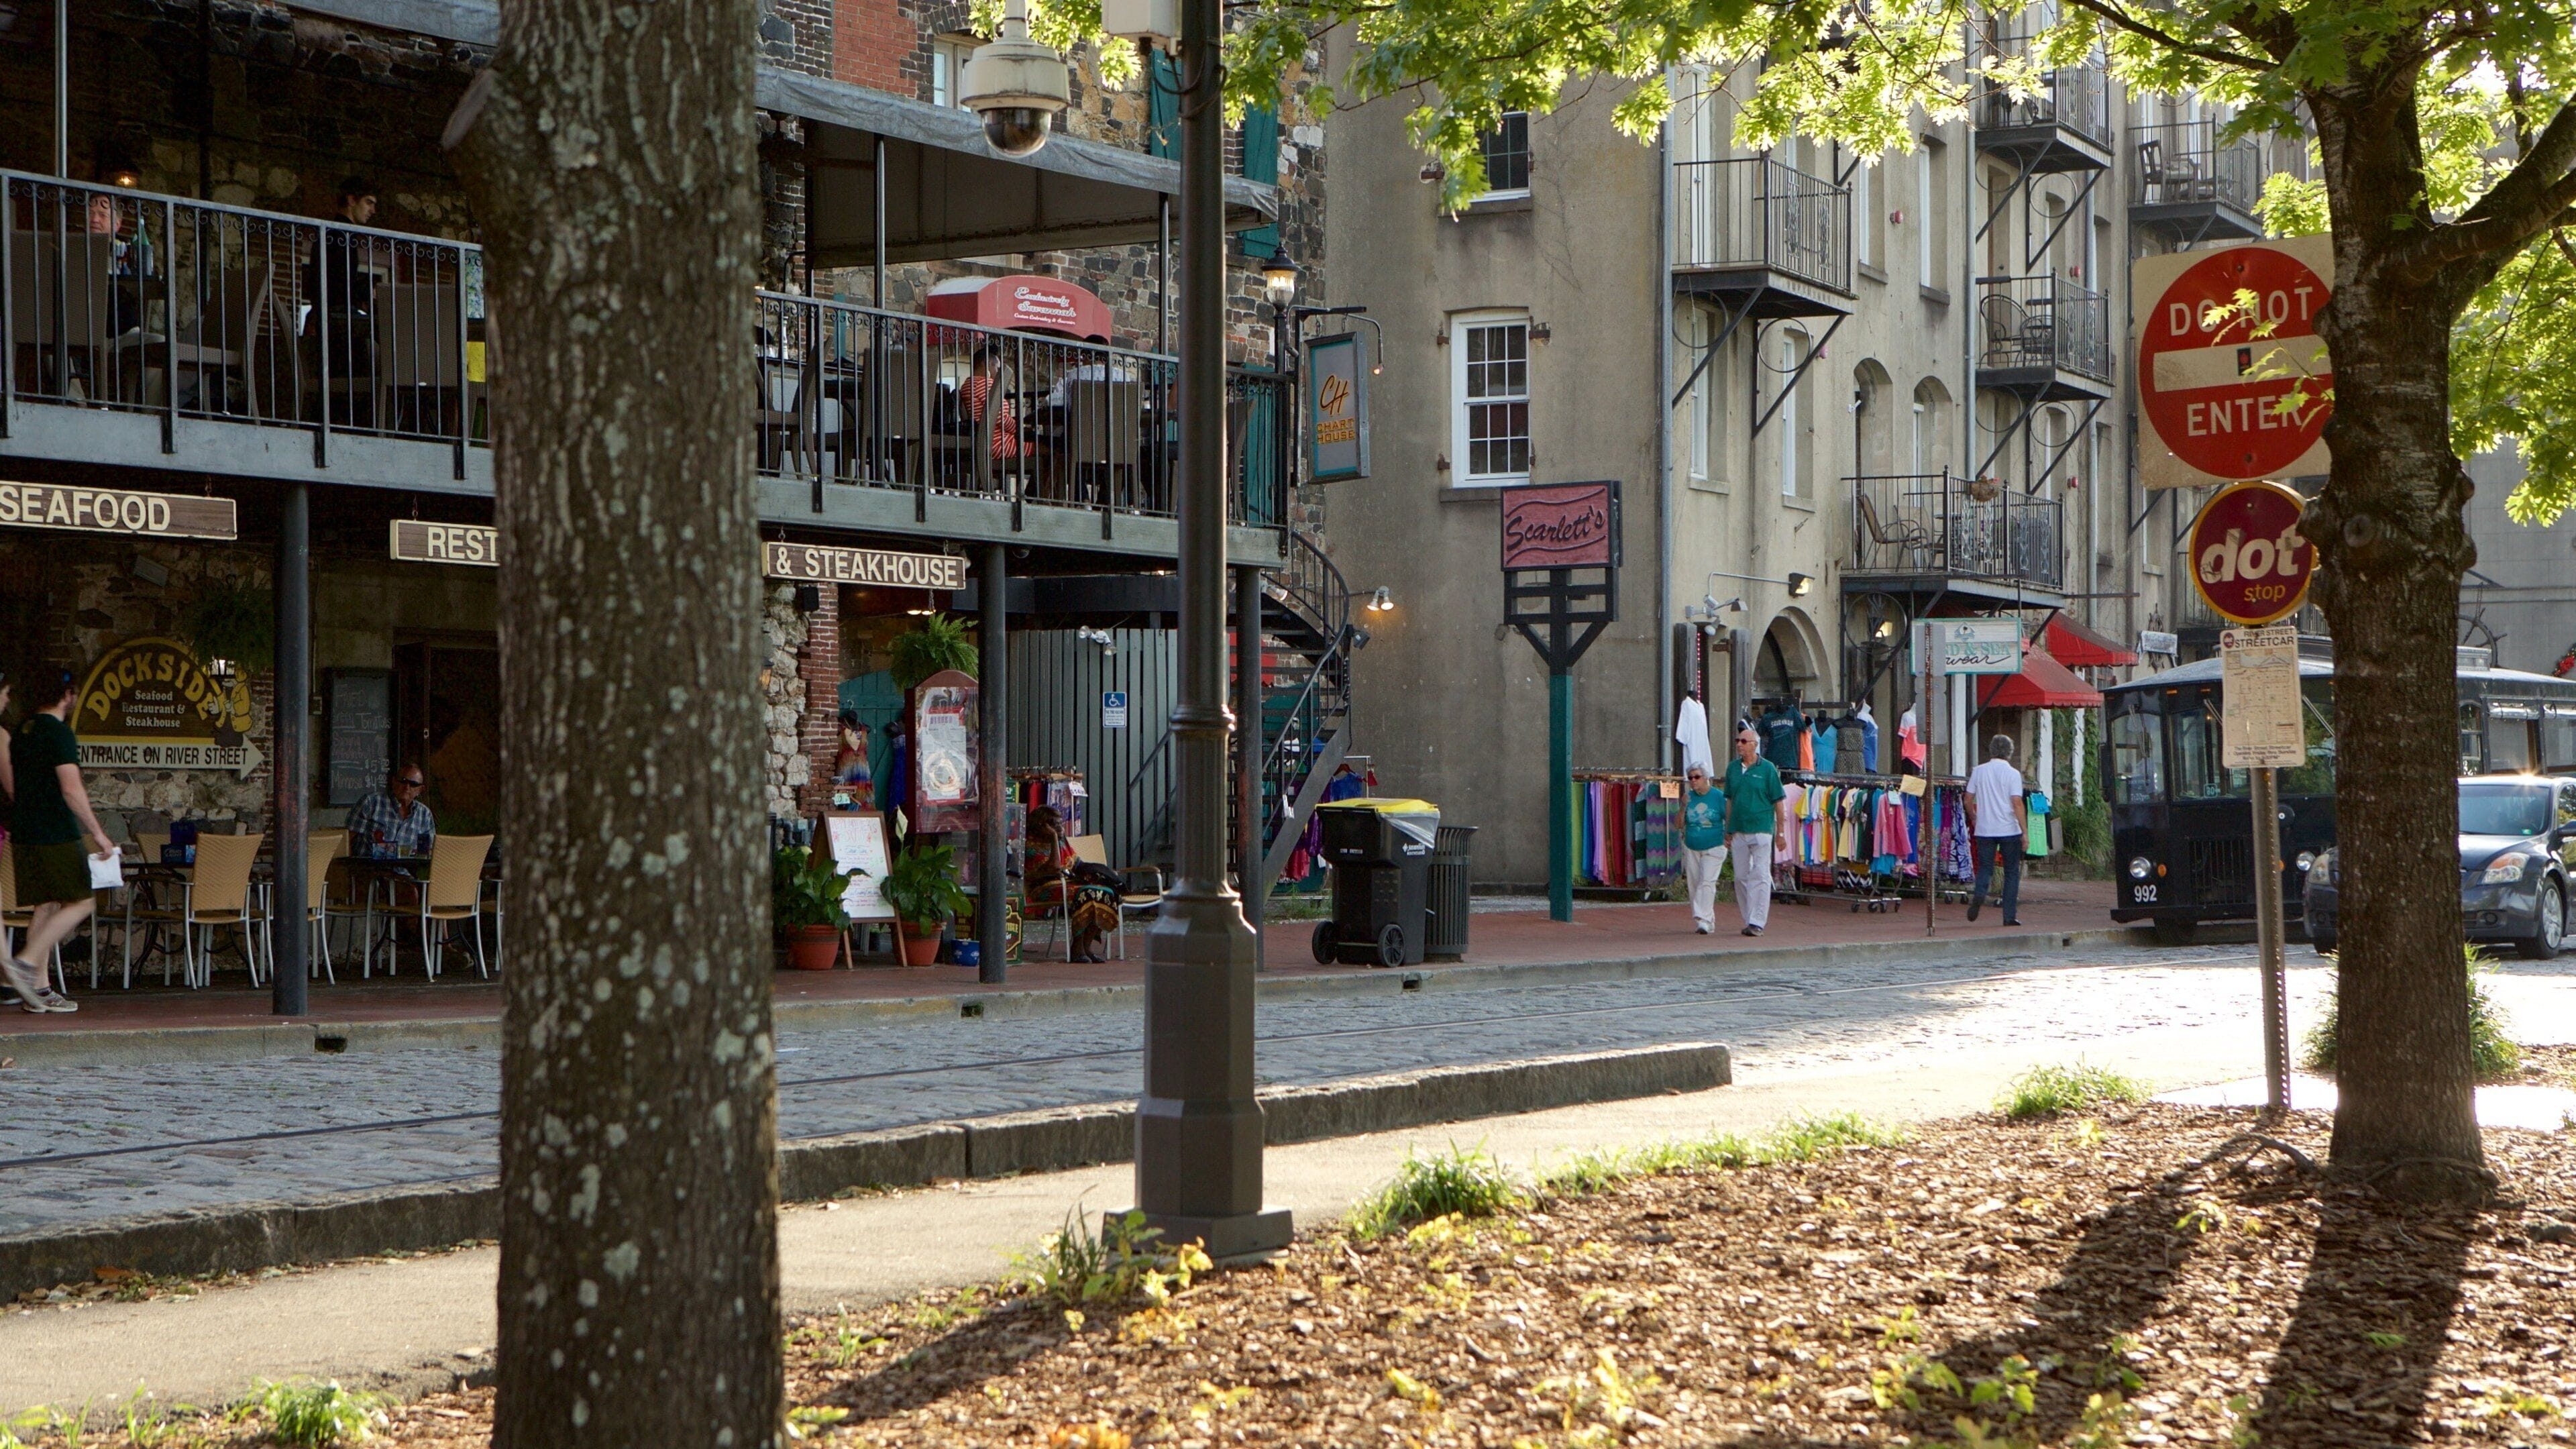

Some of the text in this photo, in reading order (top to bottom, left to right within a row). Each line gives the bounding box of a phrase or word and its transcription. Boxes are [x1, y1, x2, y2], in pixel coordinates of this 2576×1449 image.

[1014, 286, 1070, 307] Exclusively
[1018, 301, 1077, 317] Savannah
[2169, 286, 2313, 335] DO NOT
[1320, 375, 1350, 417] CH
[2187, 394, 2302, 436] ENTER
[1317, 418, 1355, 433] CHART
[1317, 429, 1355, 445] HOUSE
[0, 485, 170, 531] SEAFOOD
[1505, 504, 1605, 551] Scarlett's
[2200, 523, 2306, 584] dot
[776, 547, 958, 587] & STEAKHOUSE
[2244, 584, 2286, 602] stop
[1964, 642, 1977, 656] &
[1981, 642, 2011, 655] SEA
[2235, 636, 2294, 649] STREETCAR
[134, 690, 173, 701] Seafood
[123, 701, 186, 714] Restaurant &
[125, 716, 180, 728] Steakhouse
[144, 746, 160, 764] ON
[165, 747, 199, 765] RIVER
[205, 747, 248, 765] STREET
[2135, 884, 2157, 902] 992
